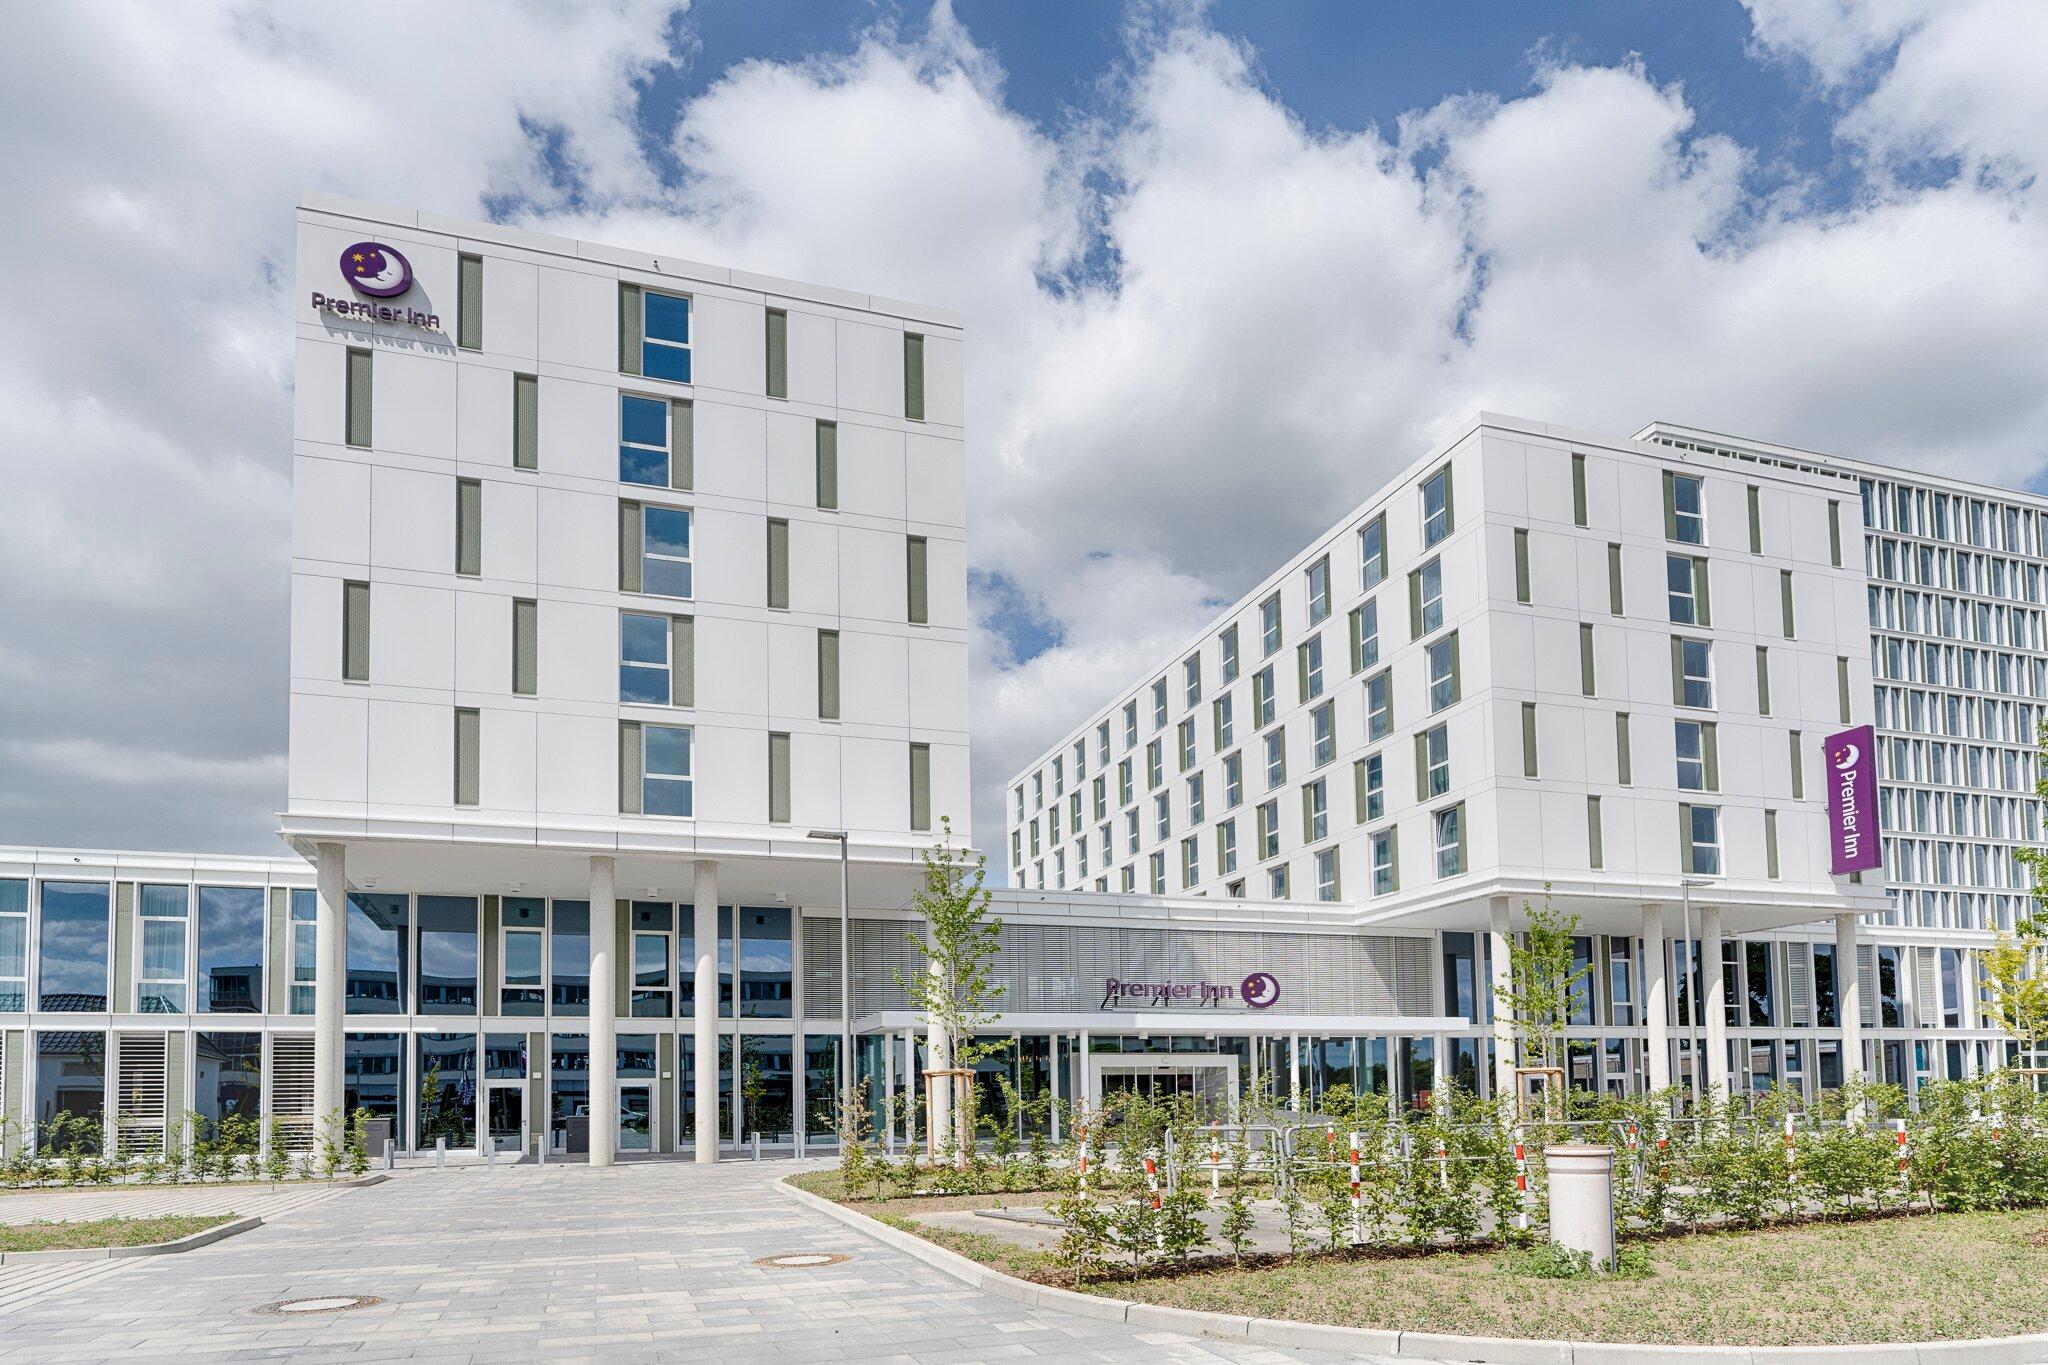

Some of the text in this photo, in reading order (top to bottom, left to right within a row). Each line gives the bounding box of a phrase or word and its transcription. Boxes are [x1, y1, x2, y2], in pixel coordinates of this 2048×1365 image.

[312, 292, 440, 328] Premier Inn
[1841, 770, 1860, 858] Premier Inn
[1106, 977, 1234, 998] Premier Inn
